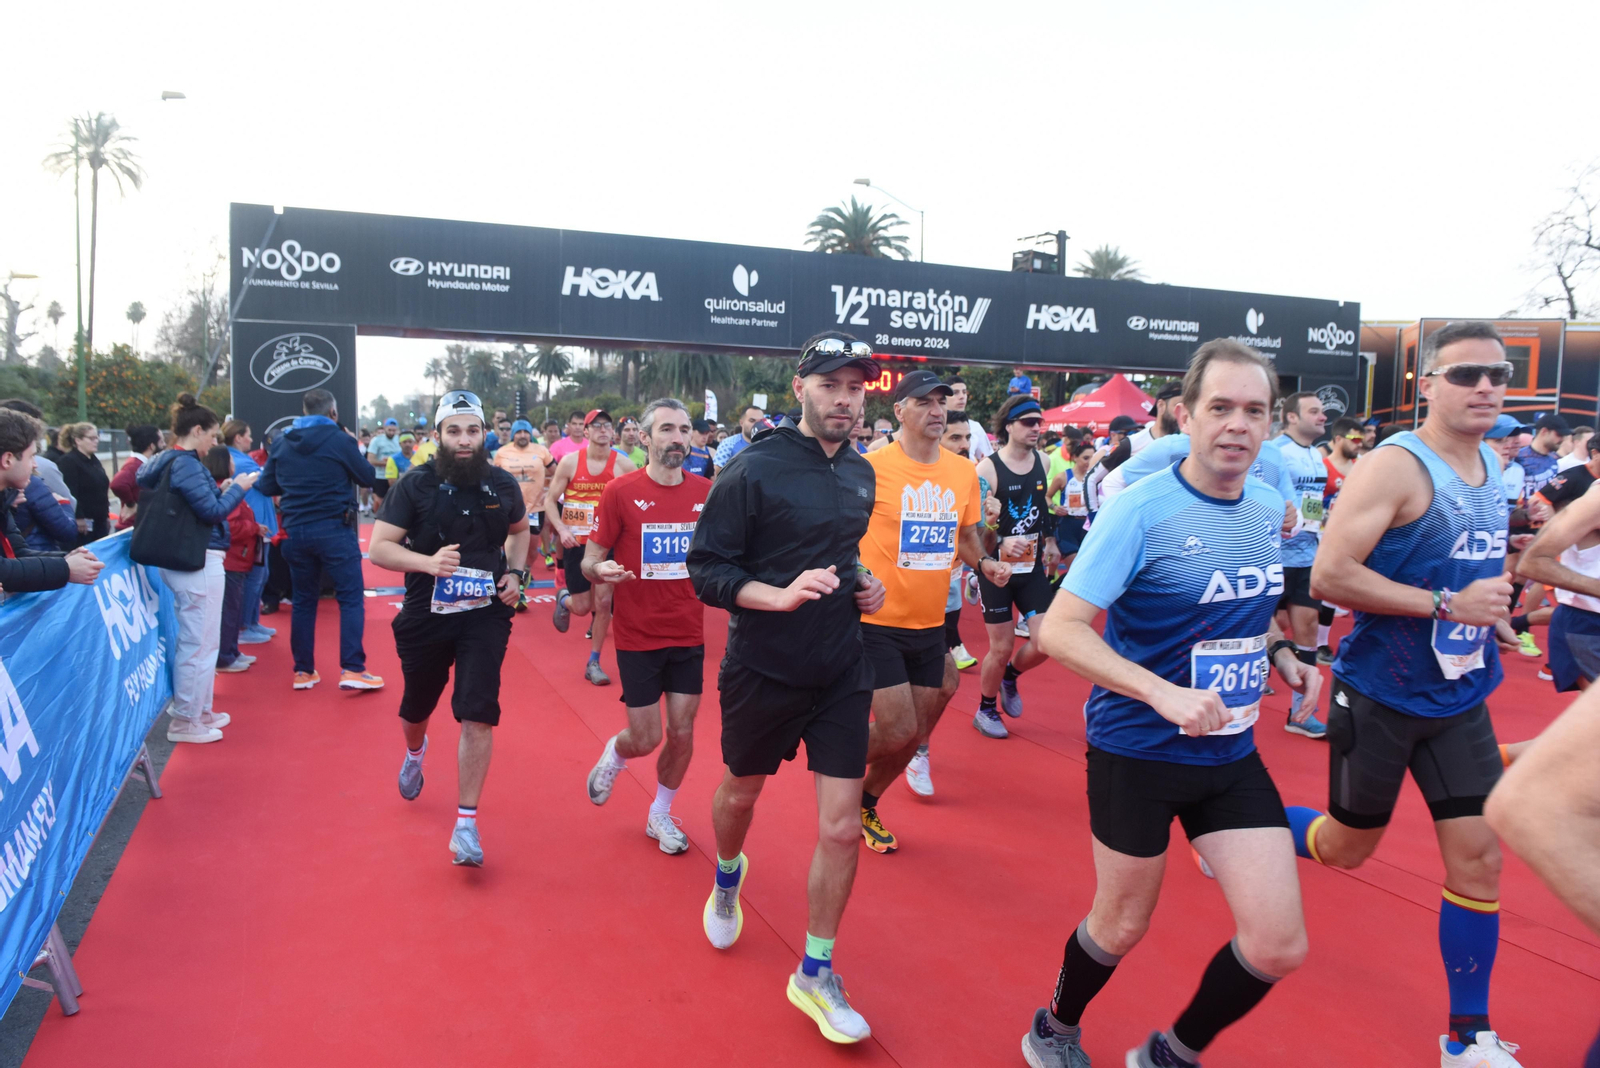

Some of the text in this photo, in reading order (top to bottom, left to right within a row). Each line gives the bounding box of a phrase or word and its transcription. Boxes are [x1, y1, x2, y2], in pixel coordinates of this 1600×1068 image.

[428, 261, 510, 281] HYUNDAI
[427, 278, 510, 293] Hyundauto Motor
[561, 265, 661, 302] HOKA
[861, 287, 968, 314] maratón
[710, 315, 779, 328] Healthcare Partner
[1025, 303, 1099, 334] HOKA
[1148, 318, 1200, 333] HYUNDAI
[875, 334, 950, 350] 28 enero 2024
[564, 510, 585, 521] 5849
[909, 525, 947, 544] 2752
[652, 535, 690, 555] 3119
[1449, 529, 1508, 561] ADS
[443, 578, 483, 597] 3196
[1197, 562, 1285, 605] ADS
[93, 563, 159, 661] HOKA
[1207, 659, 1261, 693] 2615
